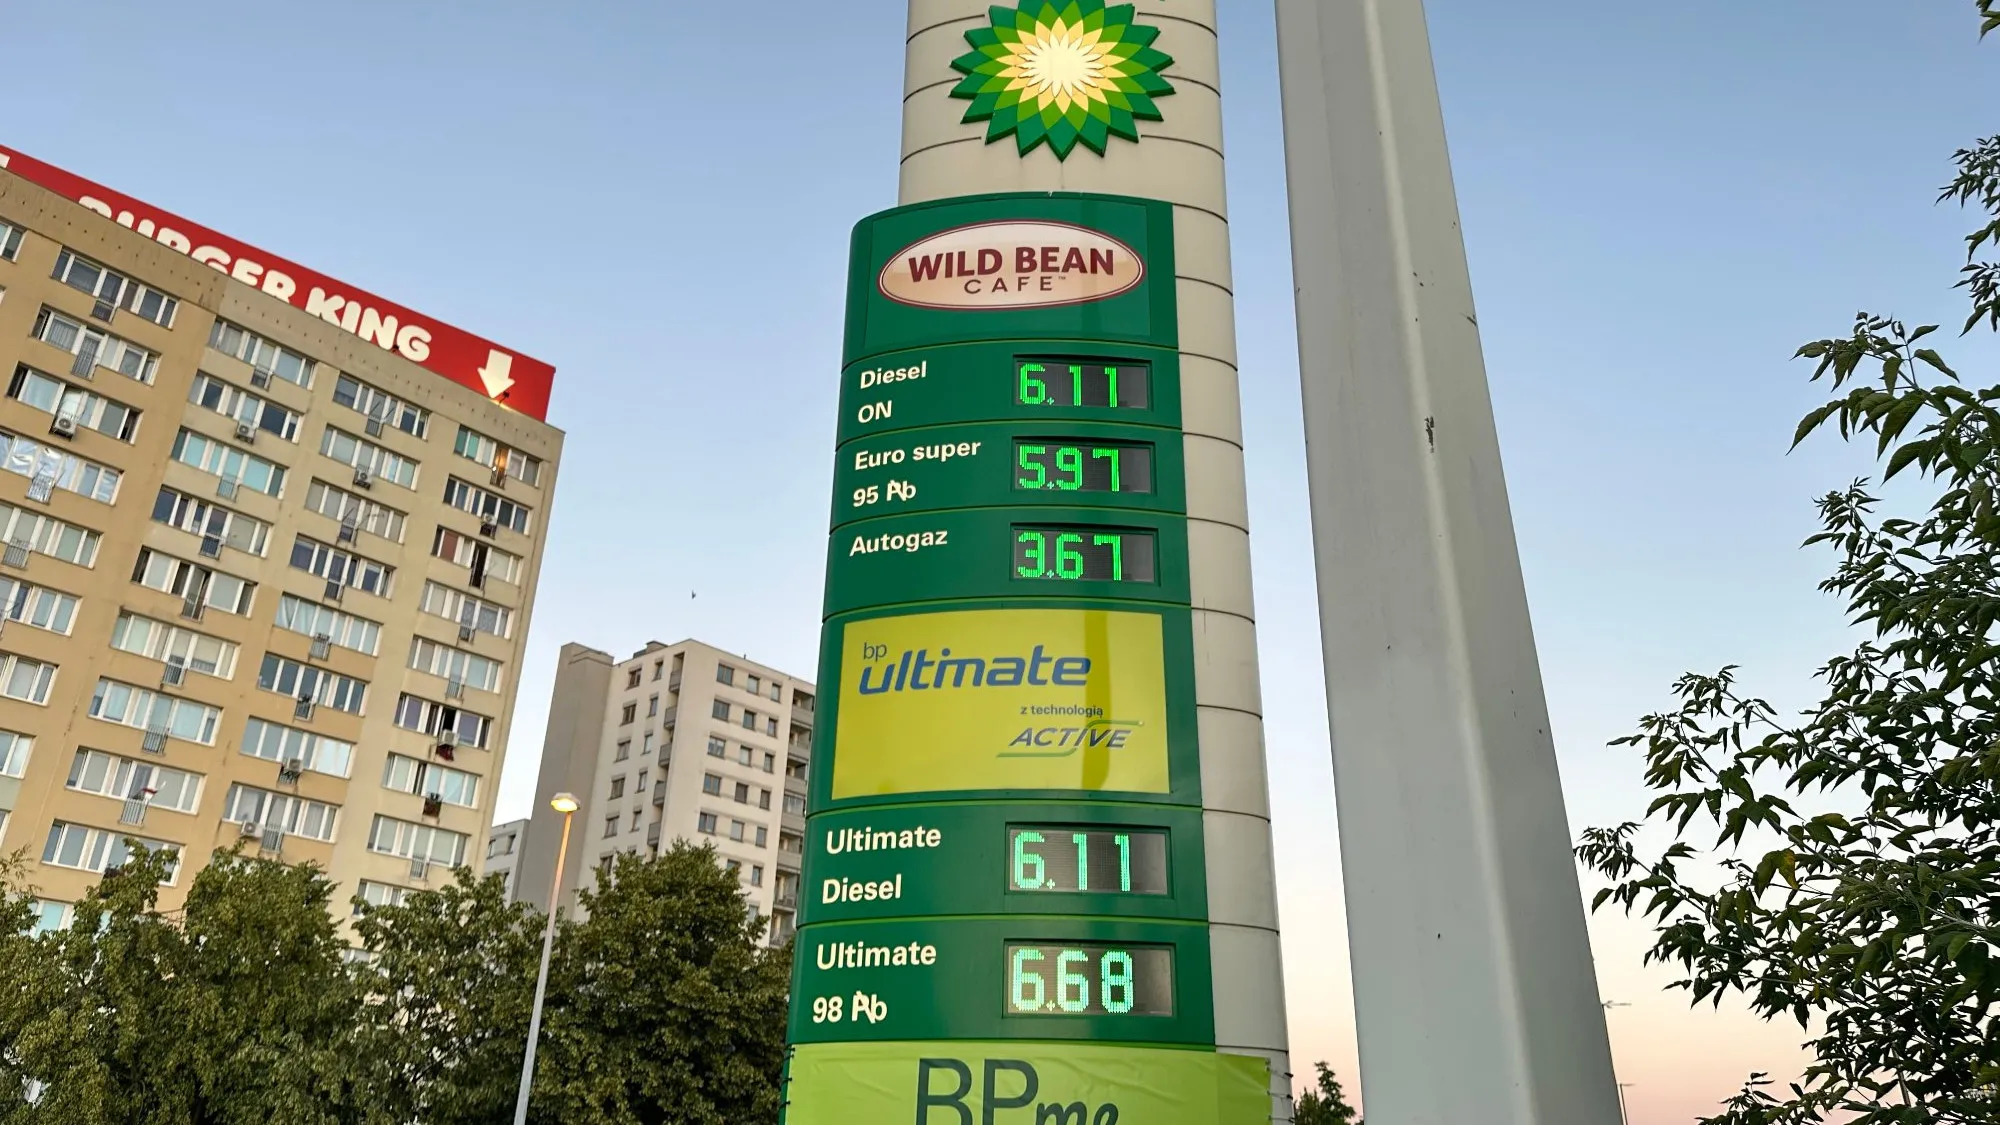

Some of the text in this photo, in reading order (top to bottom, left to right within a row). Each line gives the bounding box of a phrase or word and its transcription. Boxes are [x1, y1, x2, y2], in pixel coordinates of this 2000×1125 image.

[908, 246, 1114, 283] WILD BEAN
[963, 275, 1053, 295] CAFE
[305, 286, 432, 362] KING
[859, 361, 927, 389] Diesel
[1018, 363, 1119, 409] 6.11
[857, 401, 893, 424] ON
[854, 440, 982, 471] Euro super
[1018, 445, 1120, 492] 5.97
[852, 485, 879, 508] 95
[849, 529, 948, 558] Autogaz
[1017, 531, 1122, 581] 3.67
[862, 641, 888, 662] bp
[858, 645, 1092, 696] ultimate
[1020, 704, 1104, 719] z technologią
[1008, 727, 1132, 749] ACTIVE
[826, 825, 942, 855] Ultimate
[1013, 831, 1131, 892] 6.11
[822, 874, 902, 904] Diesel
[816, 941, 937, 971] Ultimate
[1012, 948, 1134, 1014] 6.68
[812, 996, 843, 1024] 98
